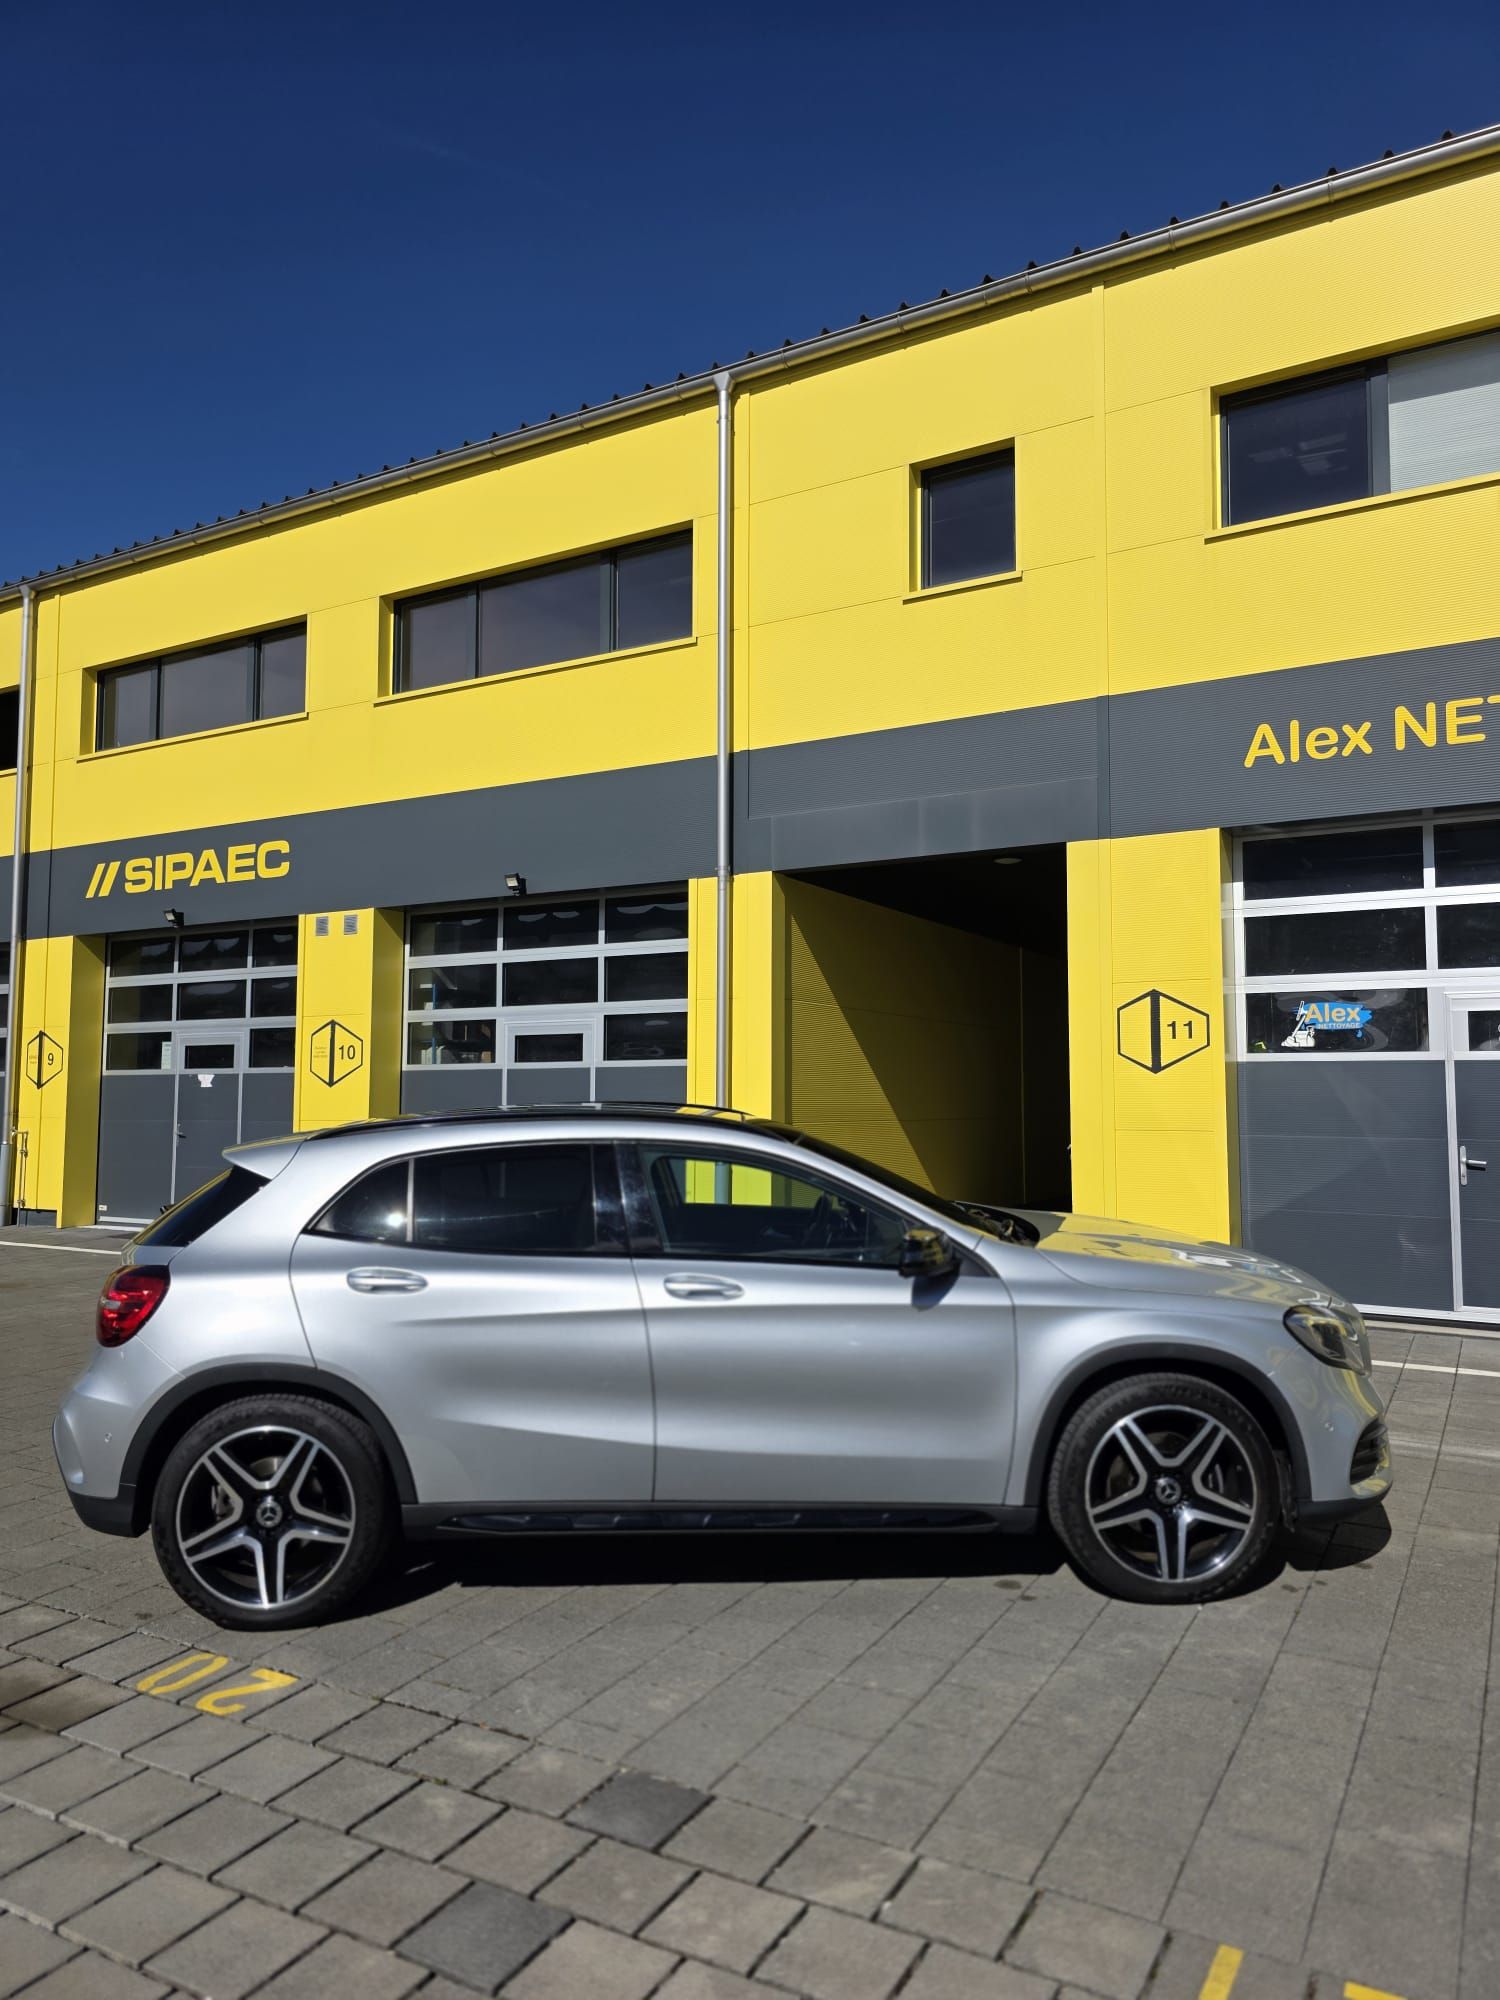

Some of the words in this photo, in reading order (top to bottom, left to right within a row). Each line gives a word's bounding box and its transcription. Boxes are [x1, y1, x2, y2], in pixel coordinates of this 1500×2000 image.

[1243, 719, 1373, 768] Alex
[1394, 694, 1500, 751] NE
[1304, 1003, 1361, 1023] Alex
[1167, 1020, 1193, 1039] 11
[1318, 1022, 1361, 1030] NETTOYAGE
[47, 1052, 54, 1065] 9
[338, 1044, 356, 1060] 10
